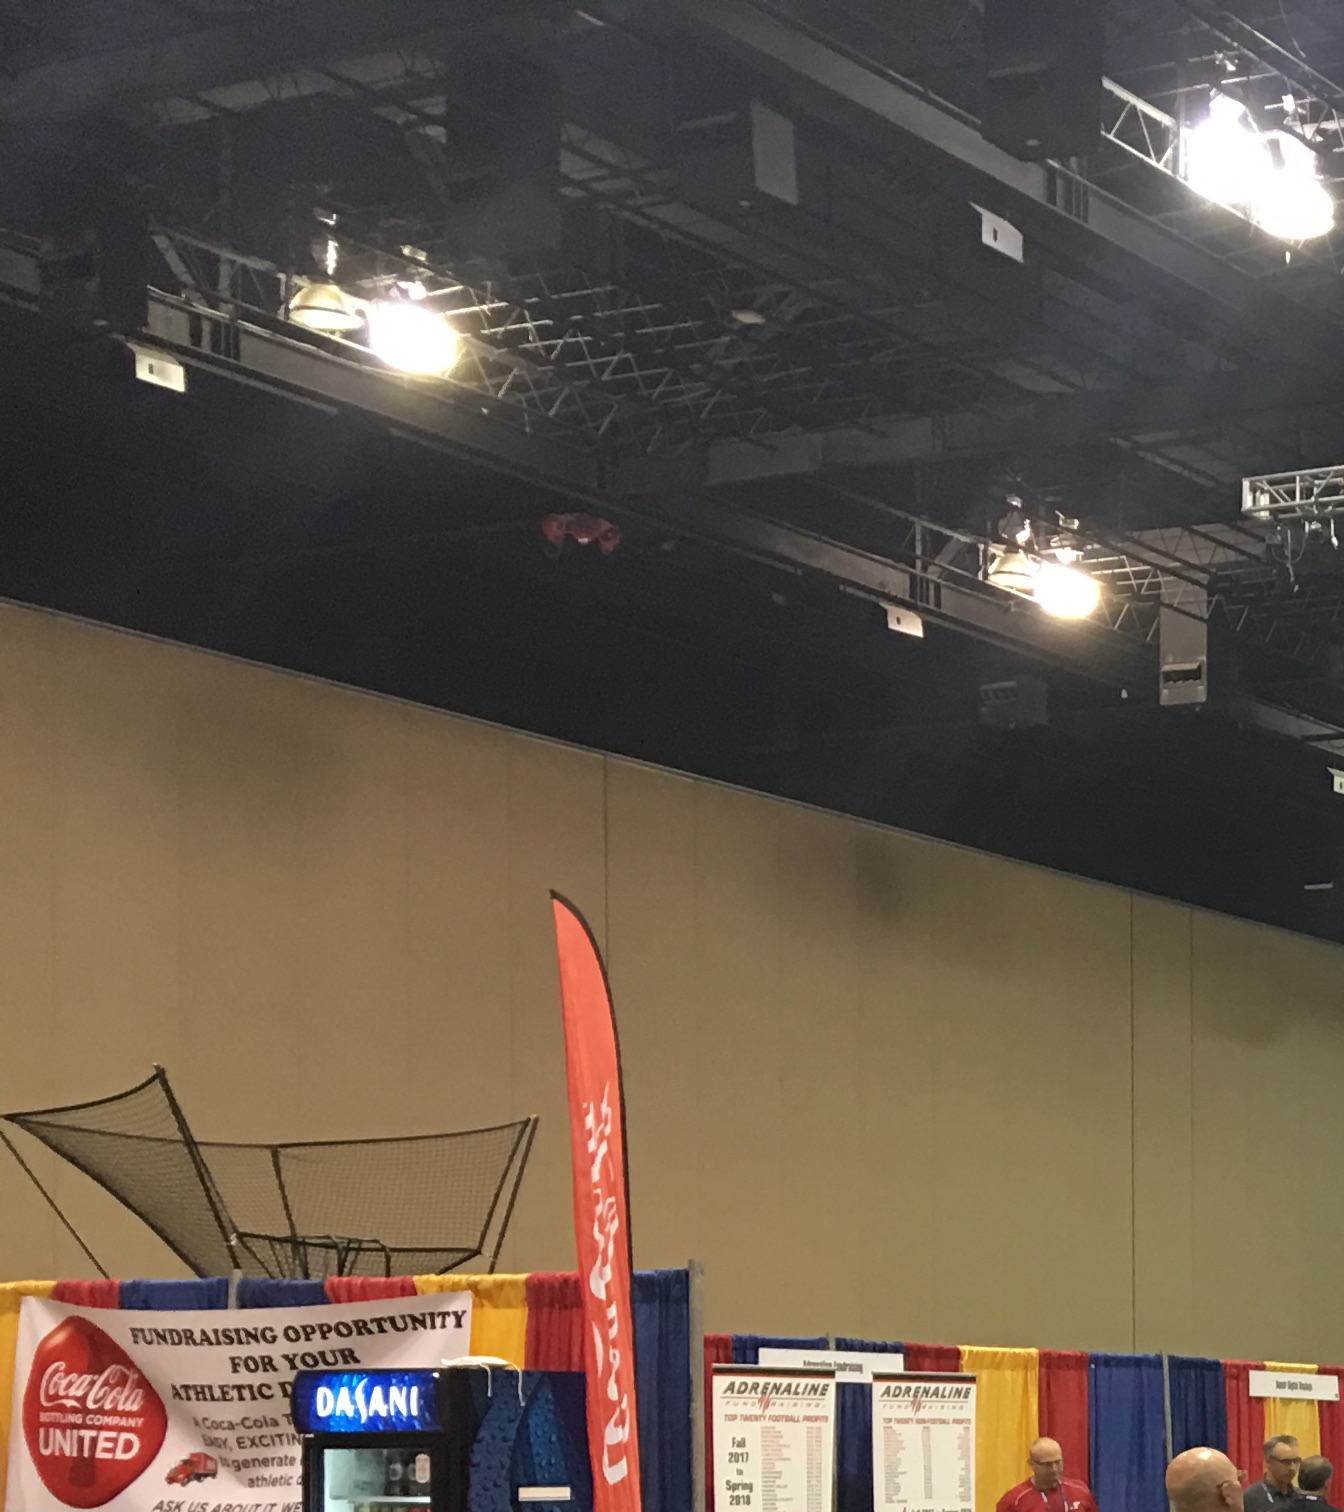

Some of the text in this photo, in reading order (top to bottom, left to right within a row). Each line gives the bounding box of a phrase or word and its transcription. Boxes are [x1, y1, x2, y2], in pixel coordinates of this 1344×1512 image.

[129, 1310, 467, 1346] FUNDRAISING OPPORTUNITY
[229, 1347, 361, 1374] FOR YOUR
[41, 1361, 144, 1411] Coca-Cola
[171, 1383, 274, 1402] ATHLETIC
[723, 1381, 829, 1397] ADRENALINE
[880, 1385, 971, 1399] ADRENALINE
[316, 1377, 420, 1424] DASANI
[86, 1414, 144, 1427] COMPANY
[201, 1415, 280, 1431] Coca-Cola
[39, 1427, 140, 1460] UNITED
[236, 1433, 303, 1449] EXCITIN
[731, 1437, 746, 1449] Fall
[232, 1454, 297, 1472] generate
[728, 1452, 749, 1464] 2017
[736, 1467, 743, 1476] to
[247, 1473, 293, 1488] athletic
[725, 1480, 753, 1493] Spring
[729, 1495, 751, 1506] 2018
